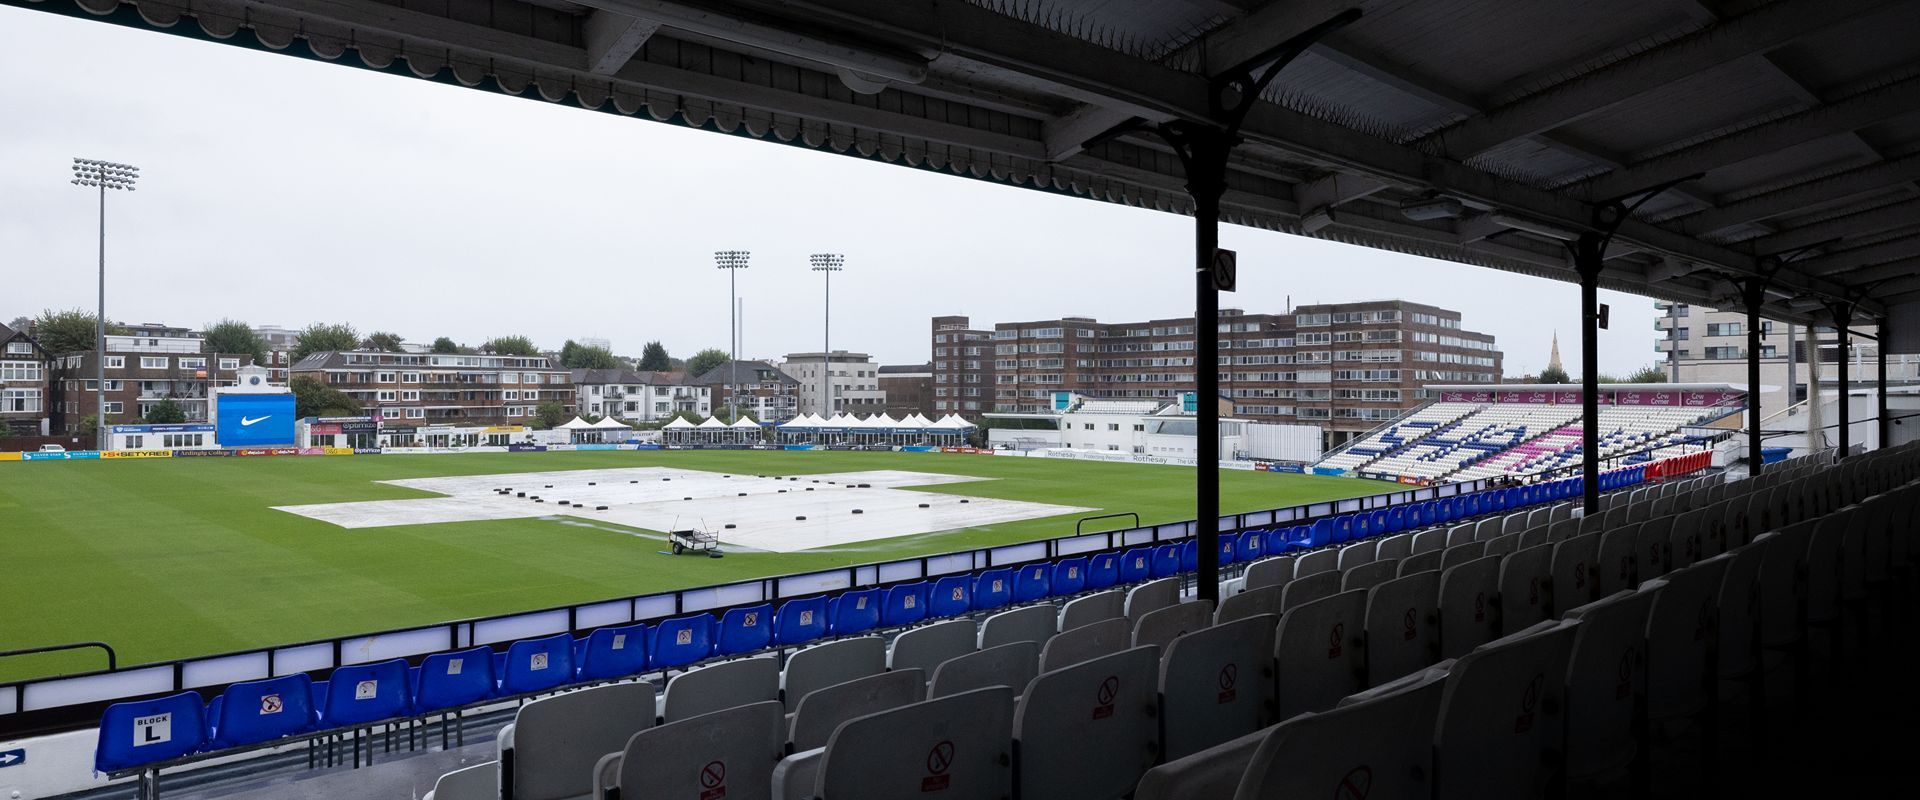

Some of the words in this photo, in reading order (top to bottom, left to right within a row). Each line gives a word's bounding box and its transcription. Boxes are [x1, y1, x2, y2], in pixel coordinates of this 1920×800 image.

[1048, 451, 1076, 459] Rothesay
[1133, 455, 1168, 464] Rothesay
[137, 715, 169, 726] BLOCK
[145, 726, 161, 742] L
